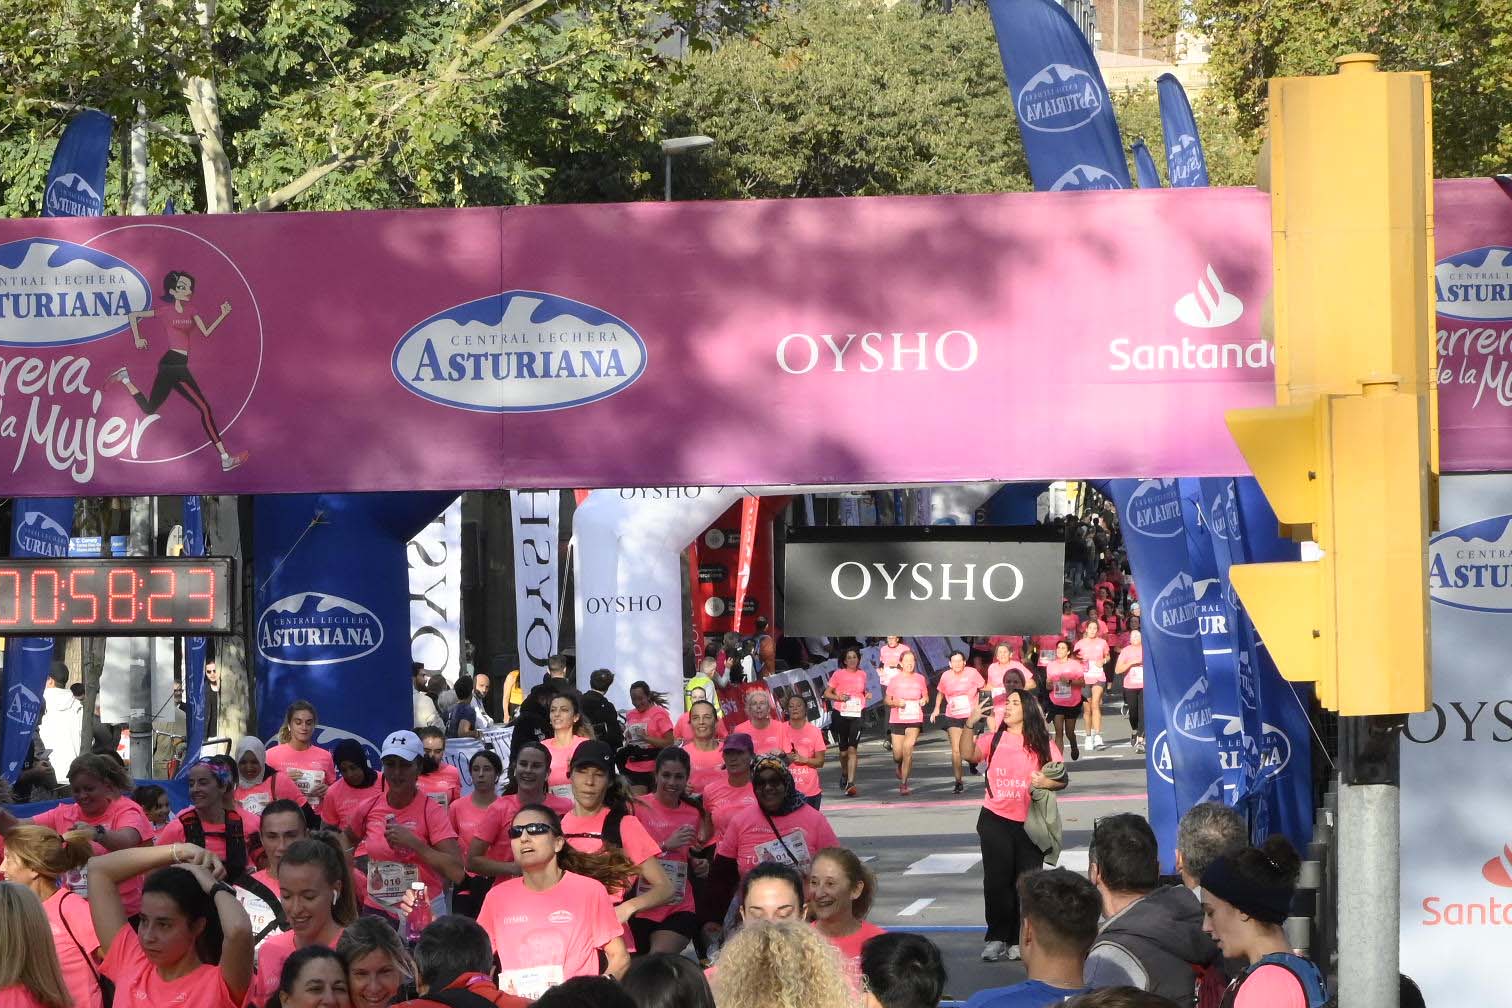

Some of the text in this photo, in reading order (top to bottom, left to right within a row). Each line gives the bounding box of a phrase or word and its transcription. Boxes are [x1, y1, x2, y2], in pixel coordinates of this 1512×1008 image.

[55, 274, 127, 286] LECHERA
[450, 331, 619, 347] CENTRAL LECHERA
[776, 330, 979, 374] OYSHO
[412, 337, 627, 383] ASTURIANA
[1110, 338, 1277, 371] Santand
[13, 391, 161, 483] Mujer
[831, 561, 1024, 602] OYSHO
[1429, 552, 1512, 589] ASTU
[586, 594, 662, 615] OYSHO
[261, 621, 375, 649] ASTURIANA
[274, 616, 370, 626] CENTRAL LECHERA
[251, 914, 265, 925] 16
